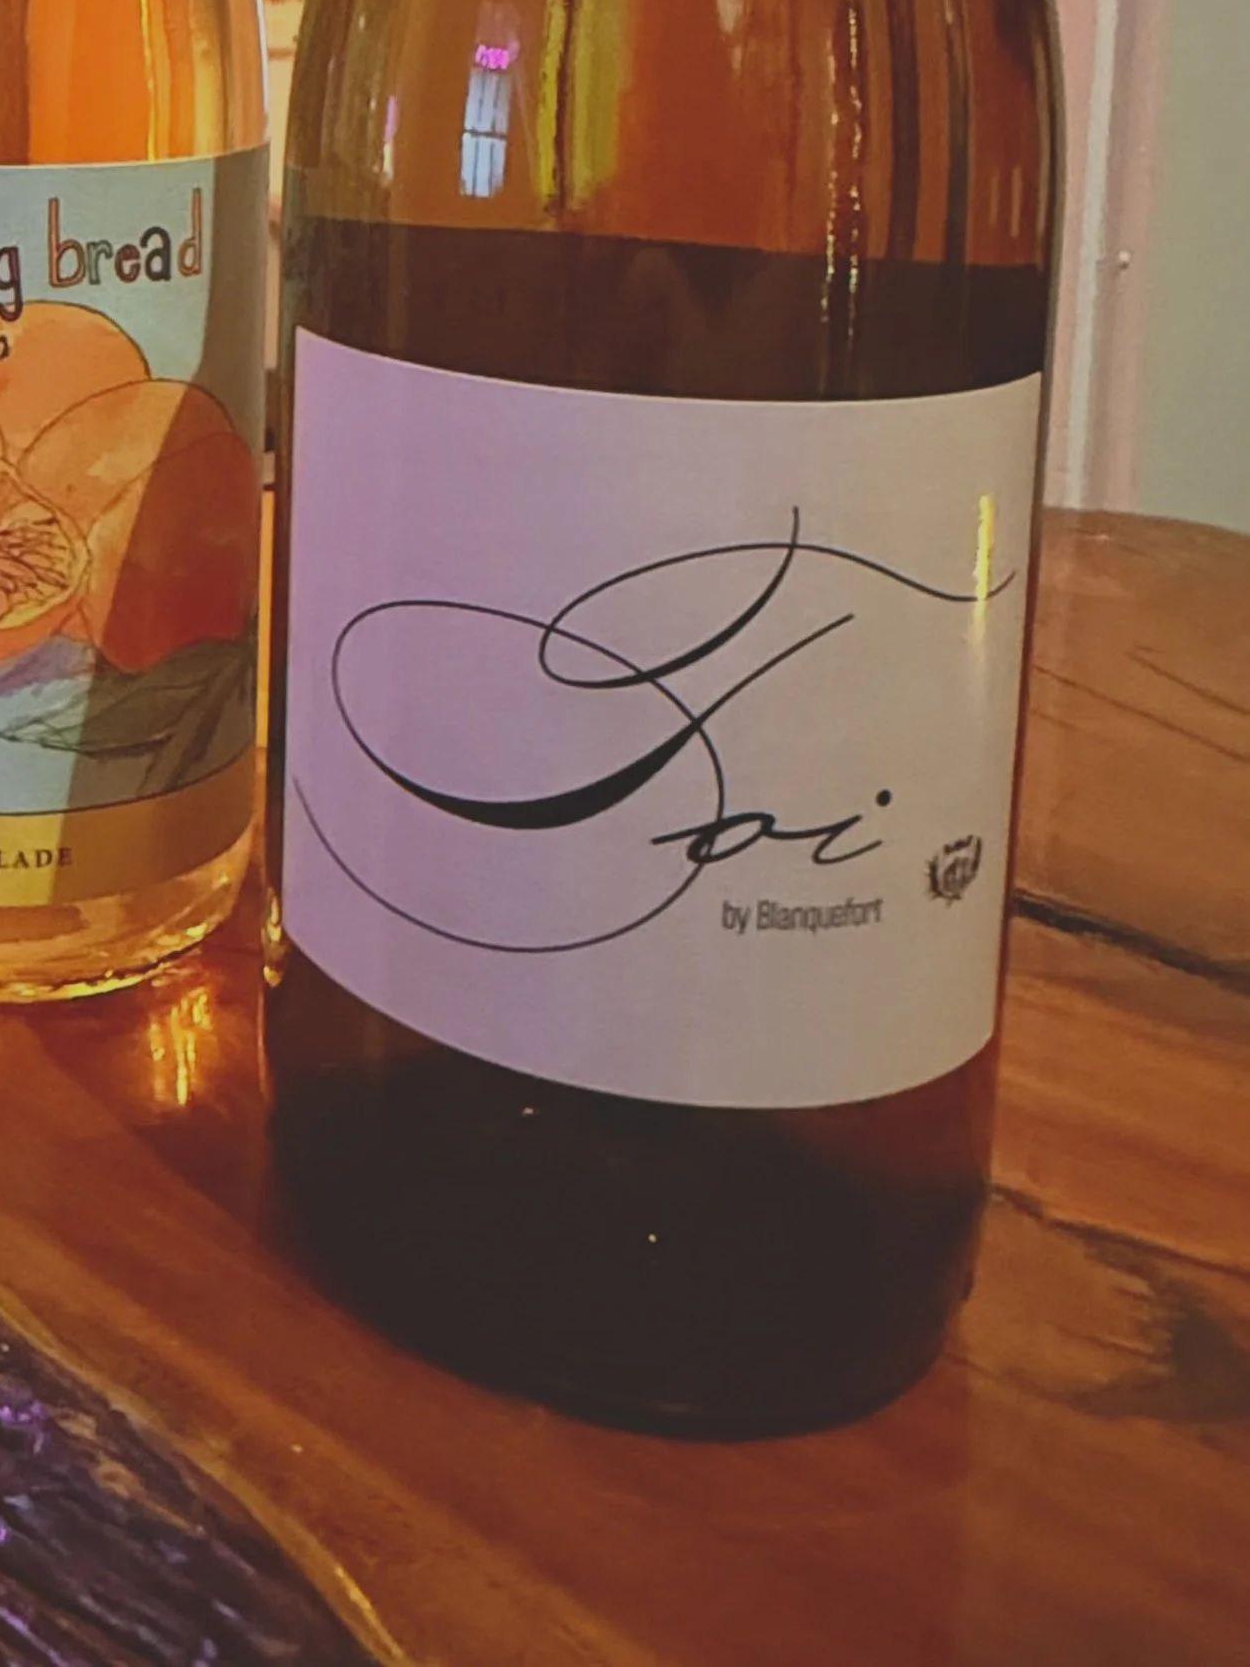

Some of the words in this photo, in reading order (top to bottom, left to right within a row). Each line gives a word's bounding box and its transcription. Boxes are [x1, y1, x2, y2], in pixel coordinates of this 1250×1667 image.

[48, 187, 202, 288] bread
[721, 899, 752, 935] by
[755, 896, 884, 935] Blanquefort
